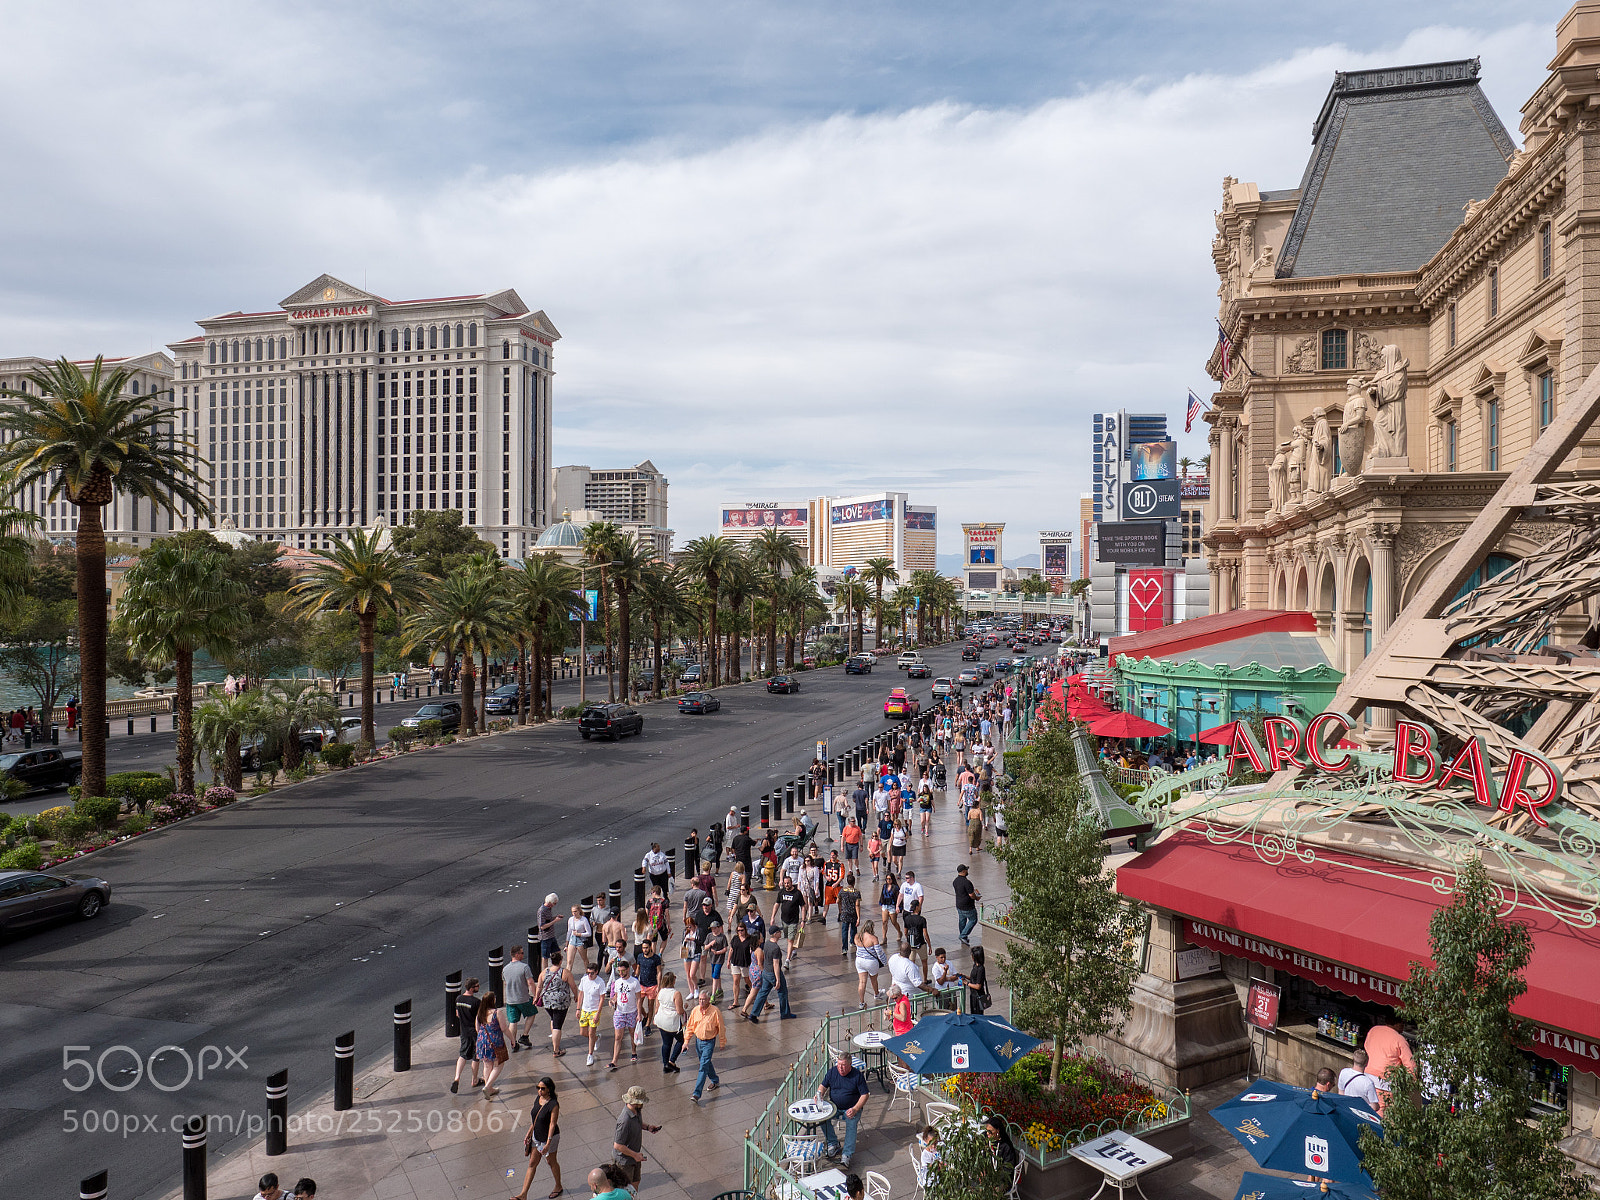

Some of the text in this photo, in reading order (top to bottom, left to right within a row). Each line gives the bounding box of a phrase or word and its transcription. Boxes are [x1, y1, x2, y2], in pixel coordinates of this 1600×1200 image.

[292, 305, 368, 320] CAESARS PALACE
[1134, 491, 1175, 508] BLT STEAK
[842, 505, 862, 520] LOVE
[1226, 712, 1564, 827] ARC BAR
[828, 870, 838, 881] 55
[1192, 922, 1242, 948] SOUVENIR
[1244, 938, 1284, 960] DRINKS
[1294, 952, 1324, 974] BEER
[1334, 966, 1358, 984] FIJI
[1258, 1000, 1268, 1012] 21
[1517, 1023, 1600, 1060] CKTAILS
[953, 1048, 968, 1056] Lite
[1308, 1142, 1326, 1153] Lite
[1094, 1143, 1148, 1168] Lite
